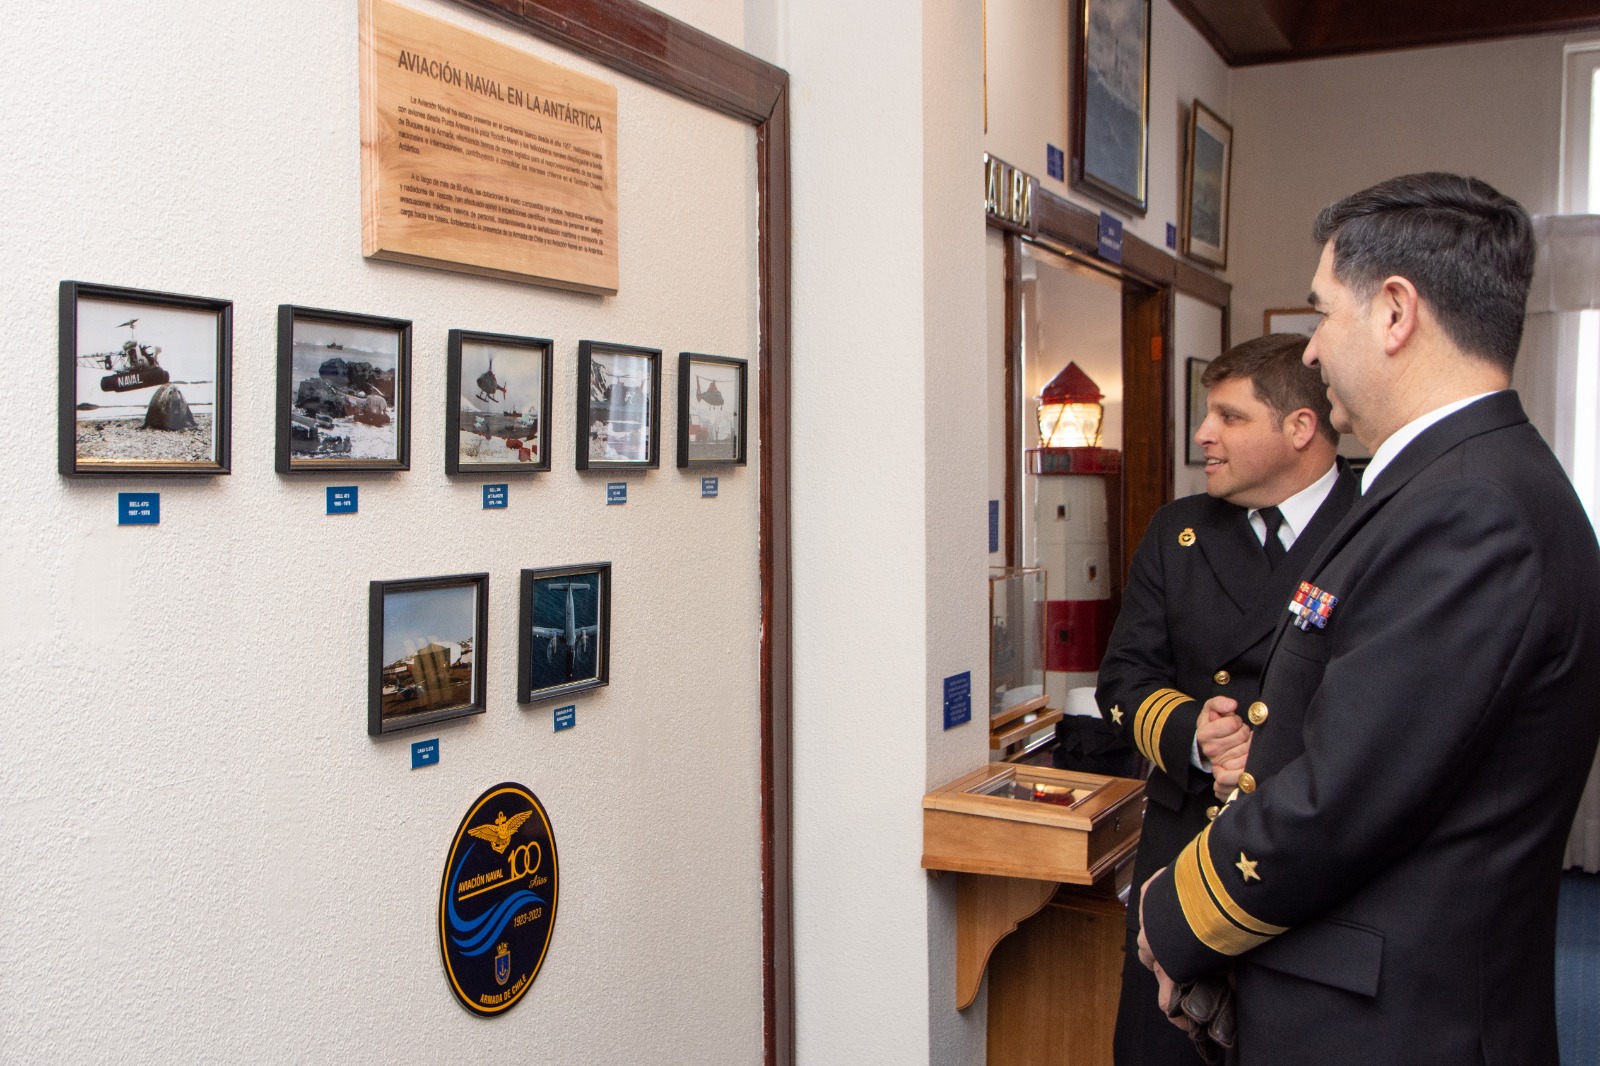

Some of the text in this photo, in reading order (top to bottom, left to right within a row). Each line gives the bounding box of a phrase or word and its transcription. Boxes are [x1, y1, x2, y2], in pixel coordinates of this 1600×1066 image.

[398, 49, 603, 134] AVIACIÓN NAVAL EN LA ANTÁRTICA
[117, 373, 143, 388] NAVAL
[507, 841, 541, 879] 100
[458, 868, 504, 893] AVIACIÓN NAVAL
[528, 876, 548, 889] Años
[513, 908, 542, 928] 1923-2023
[480, 973, 527, 1004] ARMADA DE CHILE
